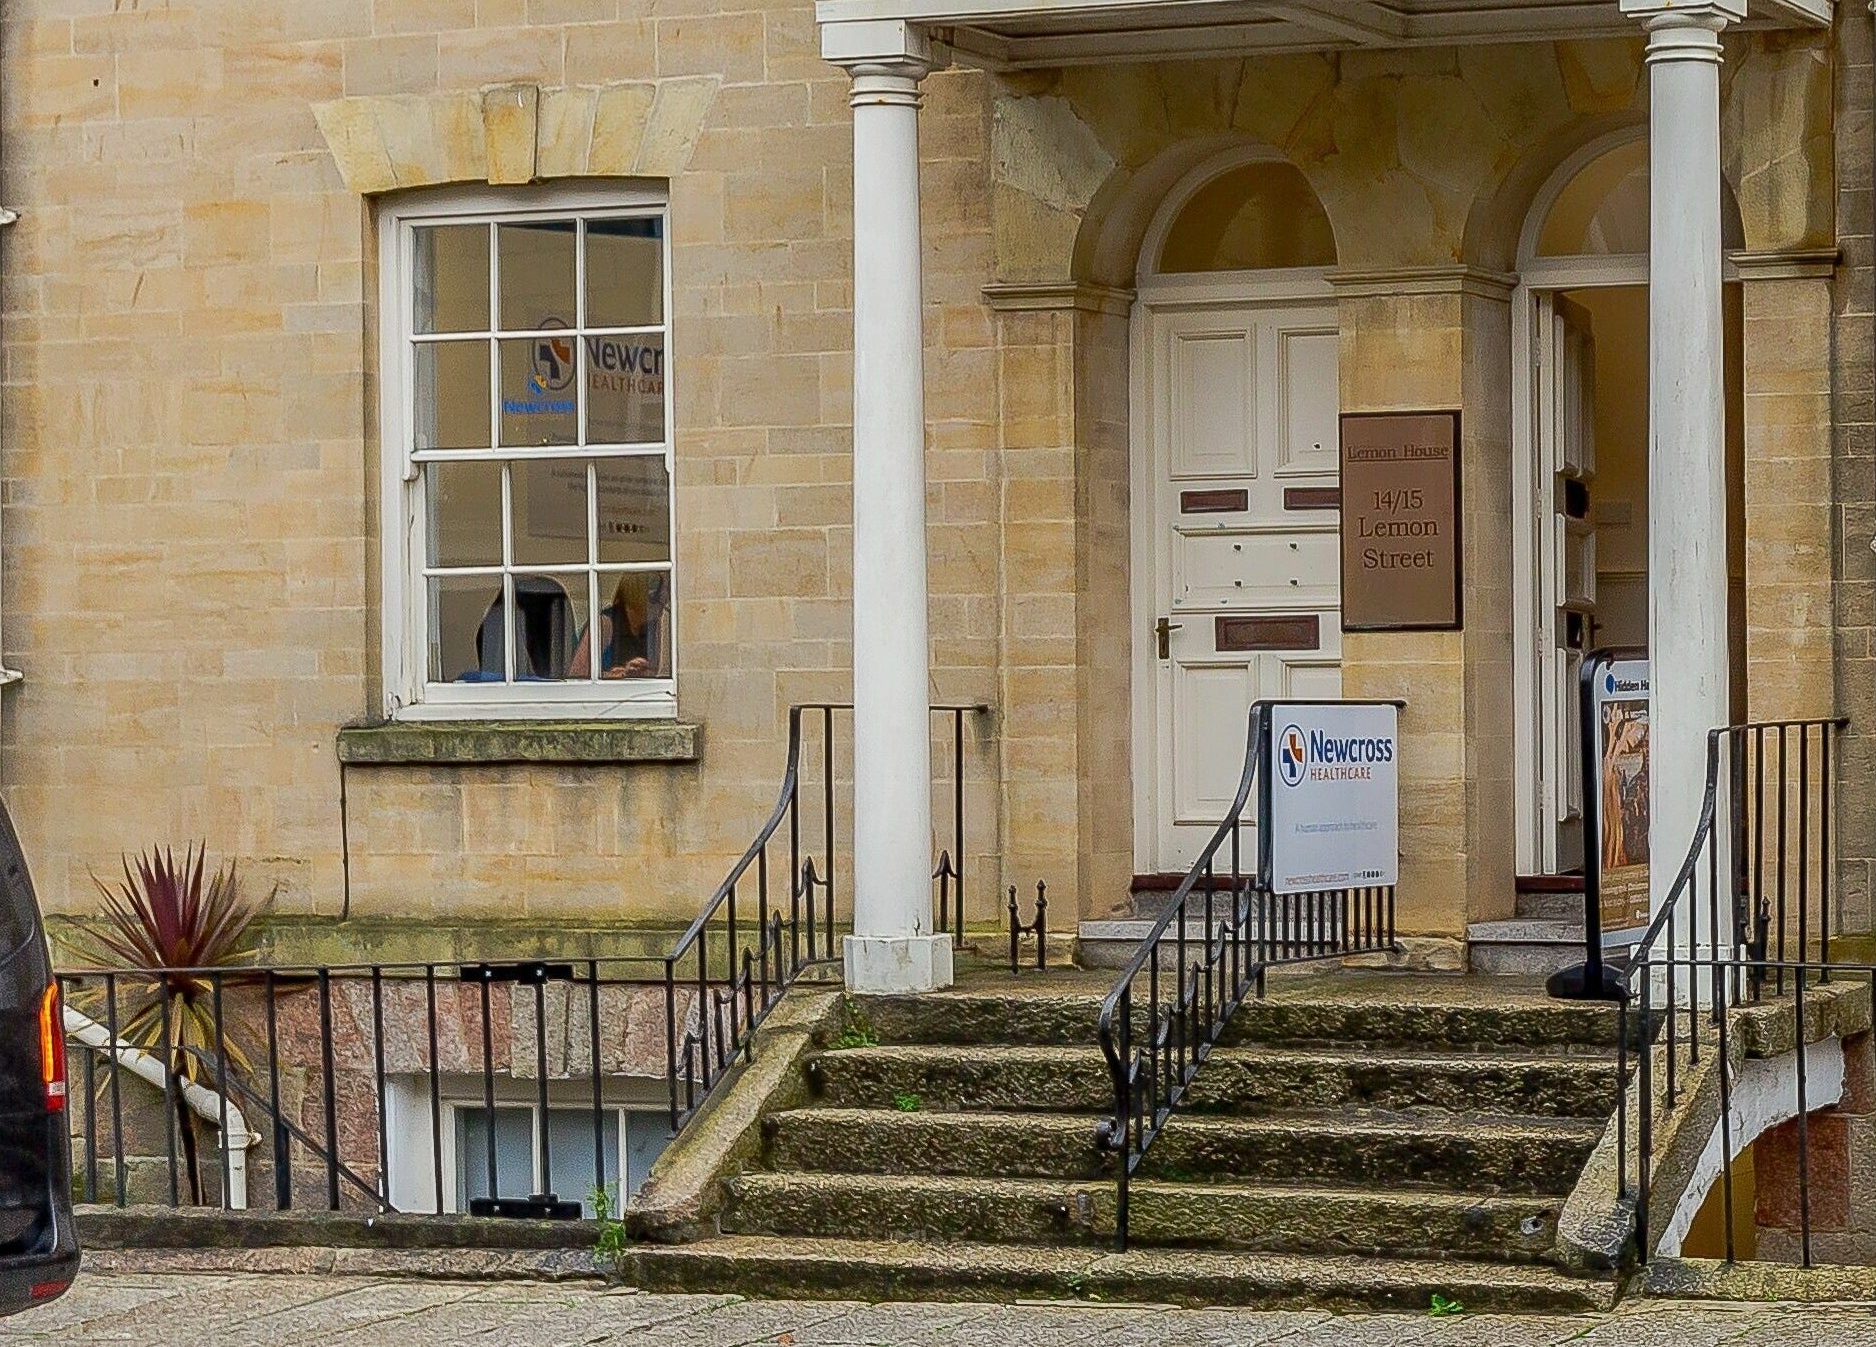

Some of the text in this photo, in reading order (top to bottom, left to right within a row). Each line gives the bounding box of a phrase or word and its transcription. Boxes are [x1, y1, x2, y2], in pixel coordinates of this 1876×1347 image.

[585, 336, 664, 375] Newcr
[588, 373, 664, 395] EALTHCAR
[1347, 444, 1450, 459] Lemon House
[1373, 489, 1423, 514] 14/15
[1358, 517, 1439, 538] Lemon
[1363, 548, 1434, 569] Street
[1310, 729, 1393, 763] Newcross
[1310, 766, 1371, 781] HEALTHCARE
